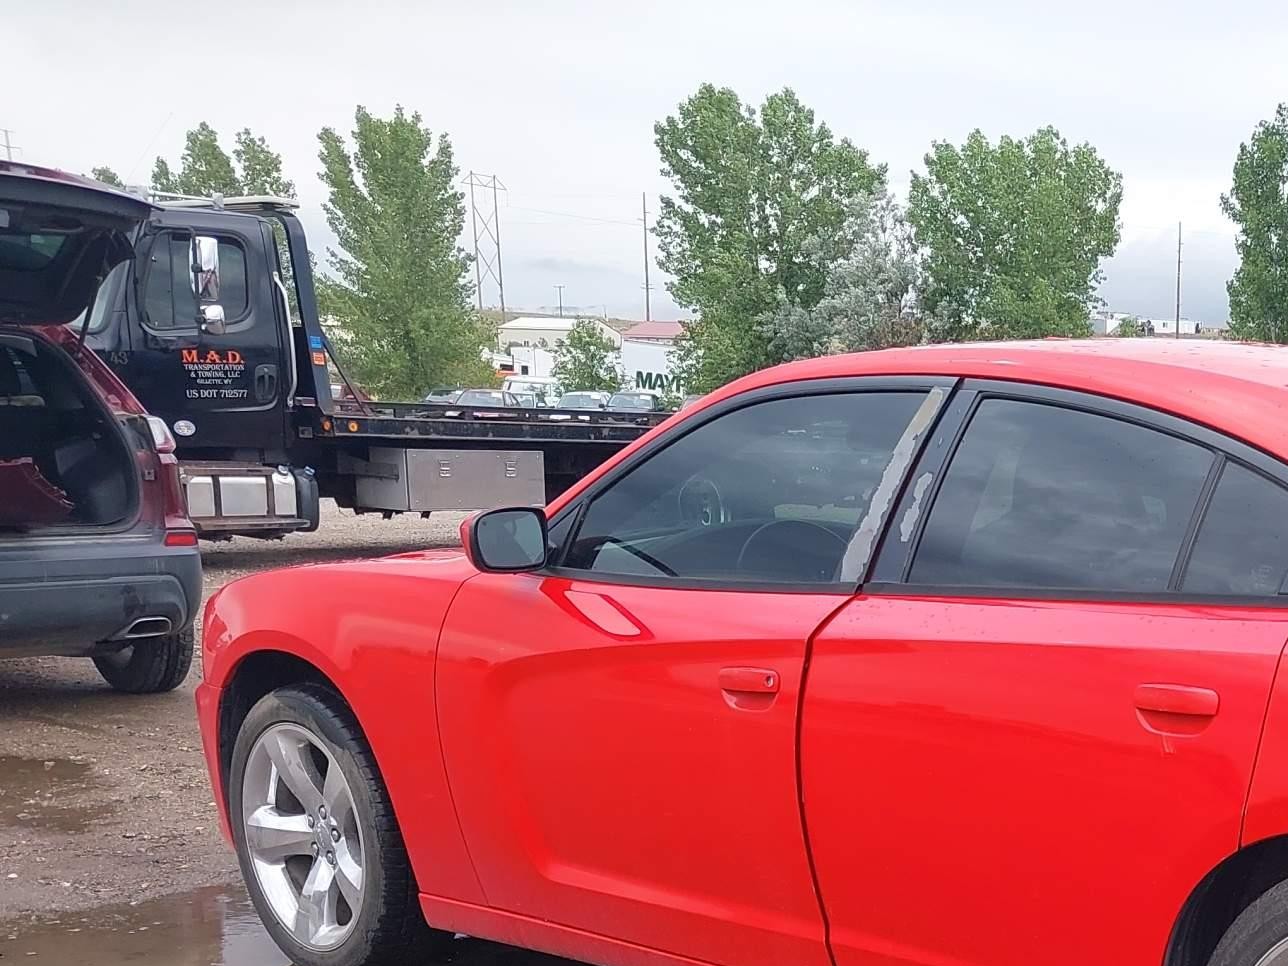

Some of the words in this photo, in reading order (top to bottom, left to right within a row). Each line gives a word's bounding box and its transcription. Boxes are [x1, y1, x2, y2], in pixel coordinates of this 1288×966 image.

[181, 349, 245, 363] M.A.D.
[186, 389, 199, 398] US
[200, 389, 219, 398] DOT
[219, 389, 248, 398] 712577
